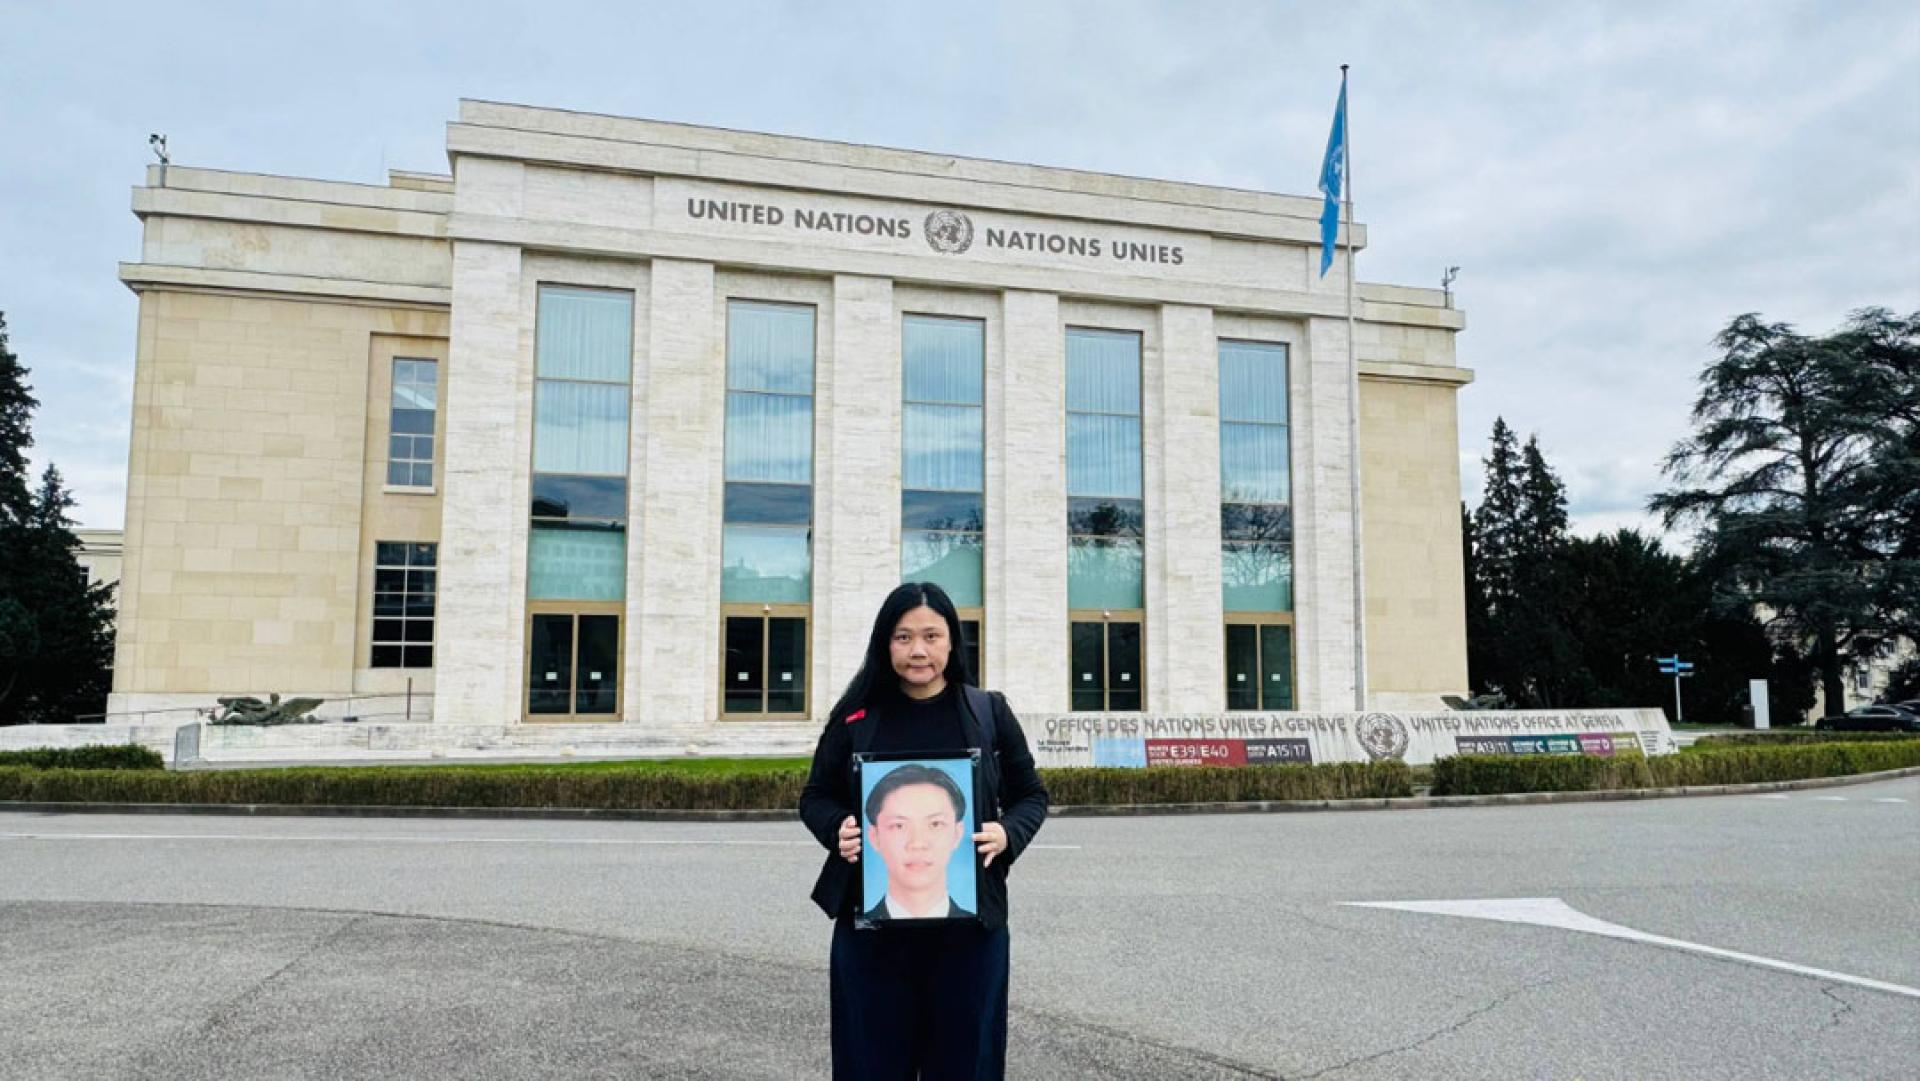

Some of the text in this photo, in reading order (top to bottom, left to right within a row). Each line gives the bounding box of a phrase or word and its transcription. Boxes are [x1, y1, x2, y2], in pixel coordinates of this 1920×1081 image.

[687, 199, 911, 239] UNITED NATIONS
[986, 227, 1184, 265] NATIONS UNIES
[1046, 717, 1103, 732] OFFICE
[1107, 717, 1139, 732] DES
[1144, 717, 1215, 732] NATIONS
[1220, 717, 1266, 732] UNIES
[1410, 716, 1461, 730] UNITED
[1464, 716, 1519, 730] NATIONS
[1521, 715, 1562, 728] OFFICE
[1565, 715, 1578, 728] AT
